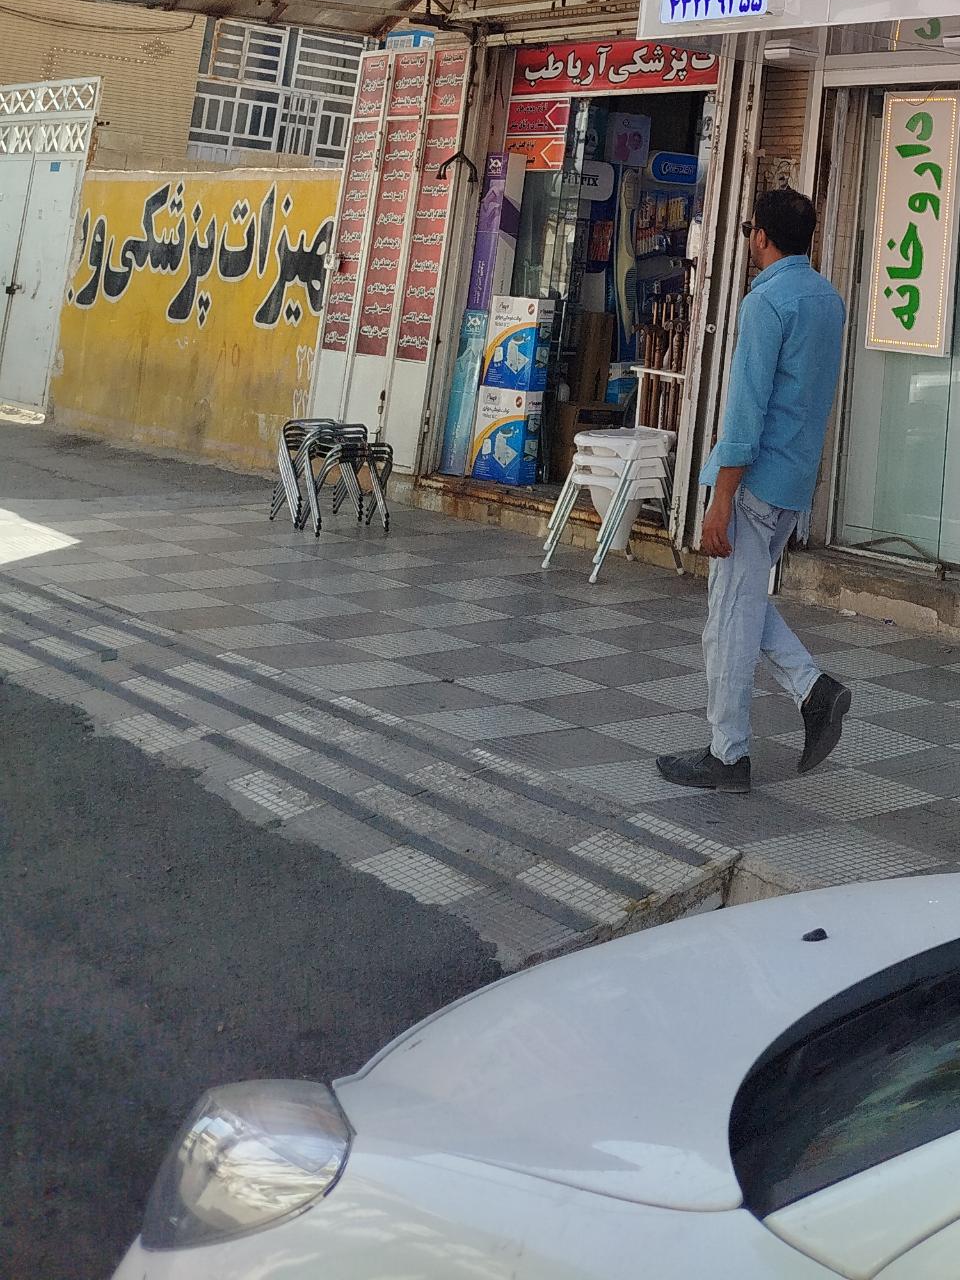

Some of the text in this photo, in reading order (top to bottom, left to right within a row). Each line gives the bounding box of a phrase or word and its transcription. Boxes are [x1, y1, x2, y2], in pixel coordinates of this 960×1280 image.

[525, 53, 565, 88] طب
[566, 45, 612, 86] آریا
[608, 45, 688, 84] پزشکی
[75, 217, 106, 307] و
[103, 181, 217, 328] پزشکی
[218, 182, 334, 326] هیزات
[883, 111, 943, 330] داروخانه
